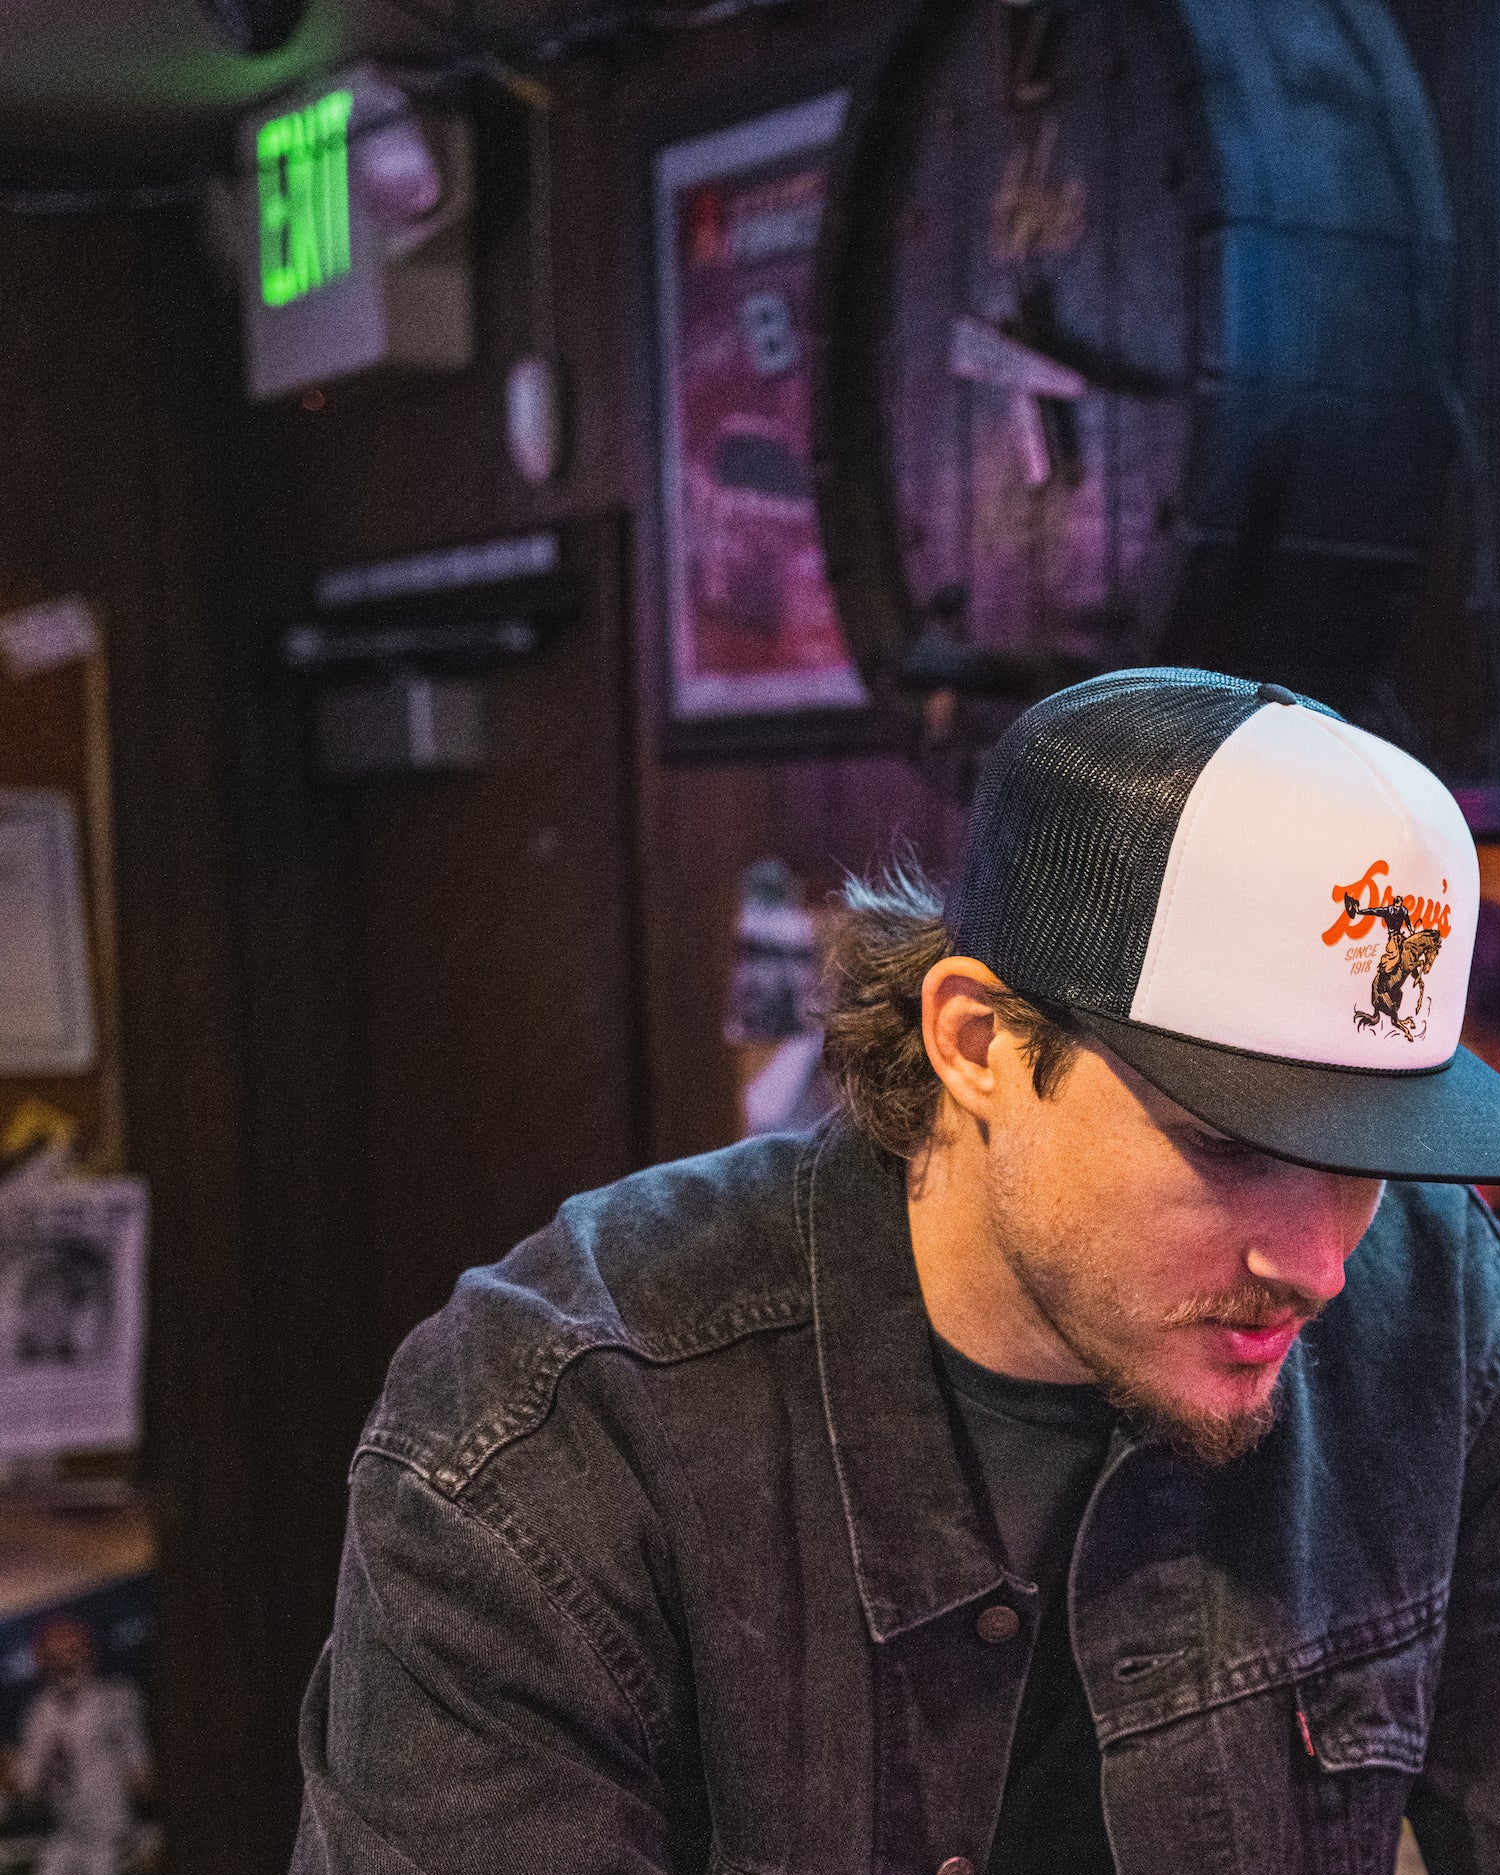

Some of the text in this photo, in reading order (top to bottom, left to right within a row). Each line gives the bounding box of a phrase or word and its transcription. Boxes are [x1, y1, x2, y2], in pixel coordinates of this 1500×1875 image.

[256, 89, 354, 307] EXIT
[1321, 859, 1452, 947] Drew's
[1344, 943, 1381, 962] SINCE
[1350, 959, 1373, 976] 1918
